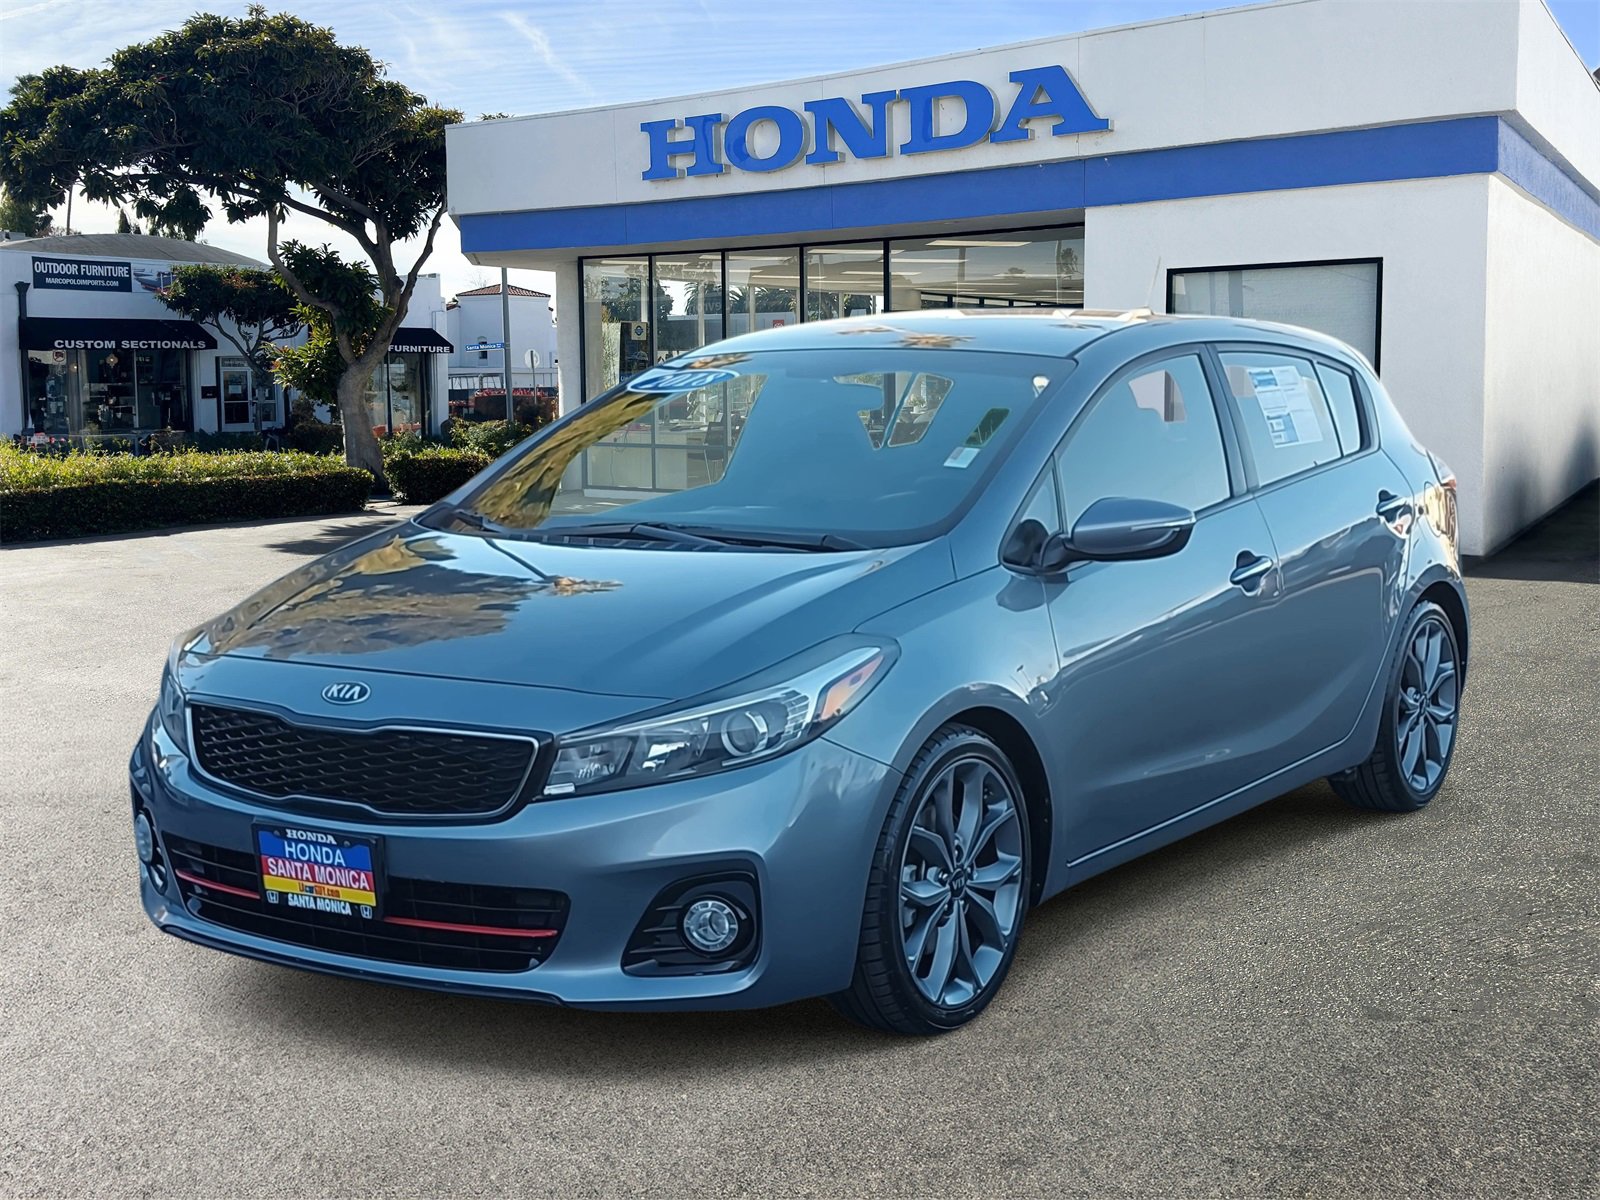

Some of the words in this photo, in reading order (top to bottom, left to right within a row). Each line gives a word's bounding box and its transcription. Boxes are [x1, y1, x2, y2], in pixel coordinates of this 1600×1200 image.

[640, 64, 1111, 181] HONDA
[34, 261, 79, 275] OUTDOOR
[80, 264, 130, 278] FURNITURE
[45, 277, 119, 287] MARCOPOLOIMPORTS.COM
[54, 339, 116, 349] CUSTOM
[121, 339, 206, 349] SECTIONALS
[388, 344, 450, 353] FURNITURE
[638, 372, 728, 389] 2018
[326, 682, 362, 700] KIA
[285, 829, 337, 845] HONDA
[284, 840, 346, 867] HONDA
[267, 858, 312, 882] SANTA
[314, 863, 371, 890] MONICA
[288, 893, 316, 909] SANTA
[316, 897, 352, 915] MONICA
